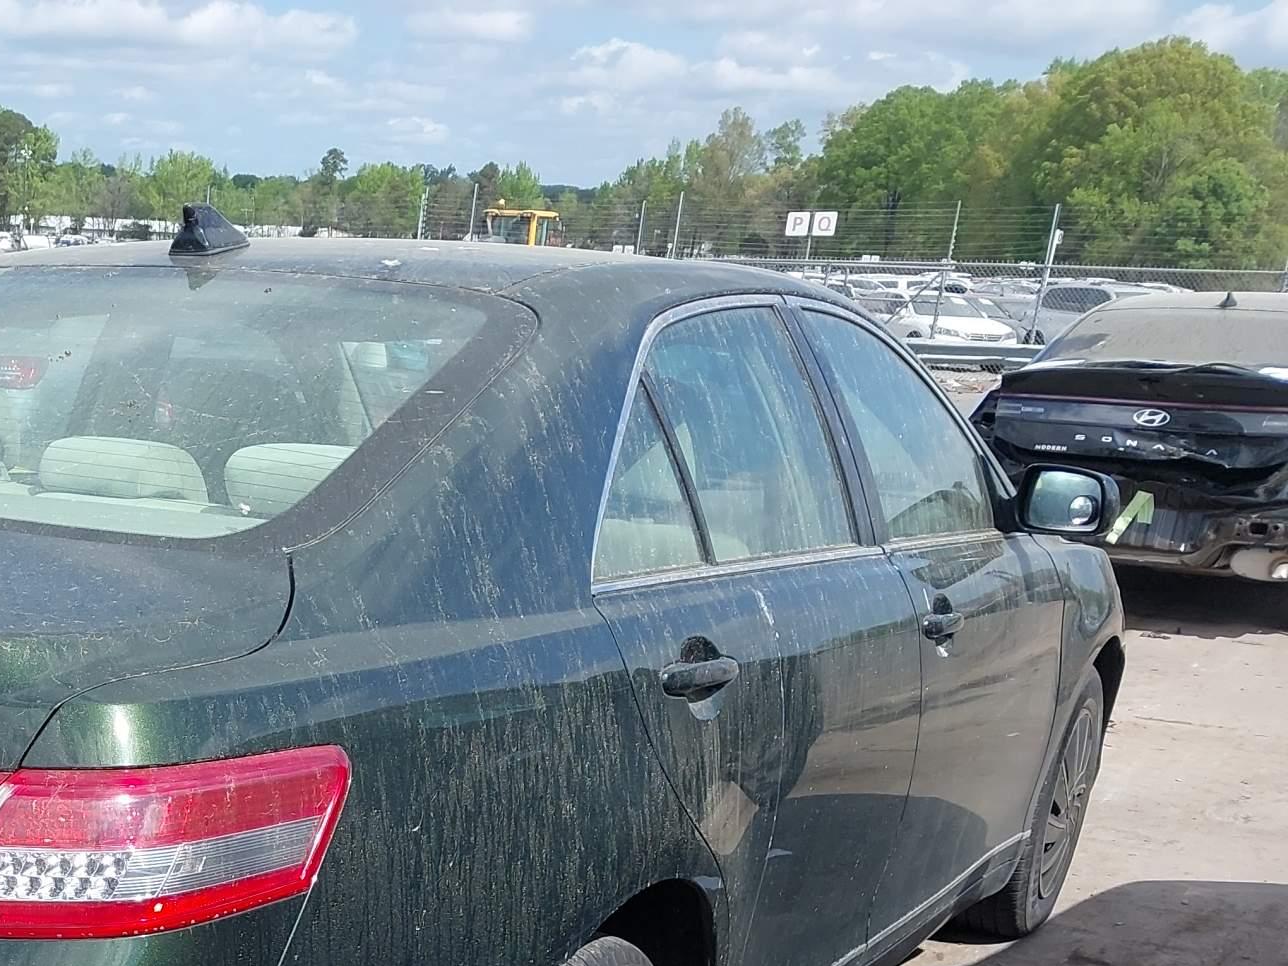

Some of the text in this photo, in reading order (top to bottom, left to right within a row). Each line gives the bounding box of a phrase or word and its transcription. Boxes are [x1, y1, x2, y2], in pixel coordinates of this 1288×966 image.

[792, 216, 832, 232] P Q
[1074, 434, 1218, 456] SONAA
